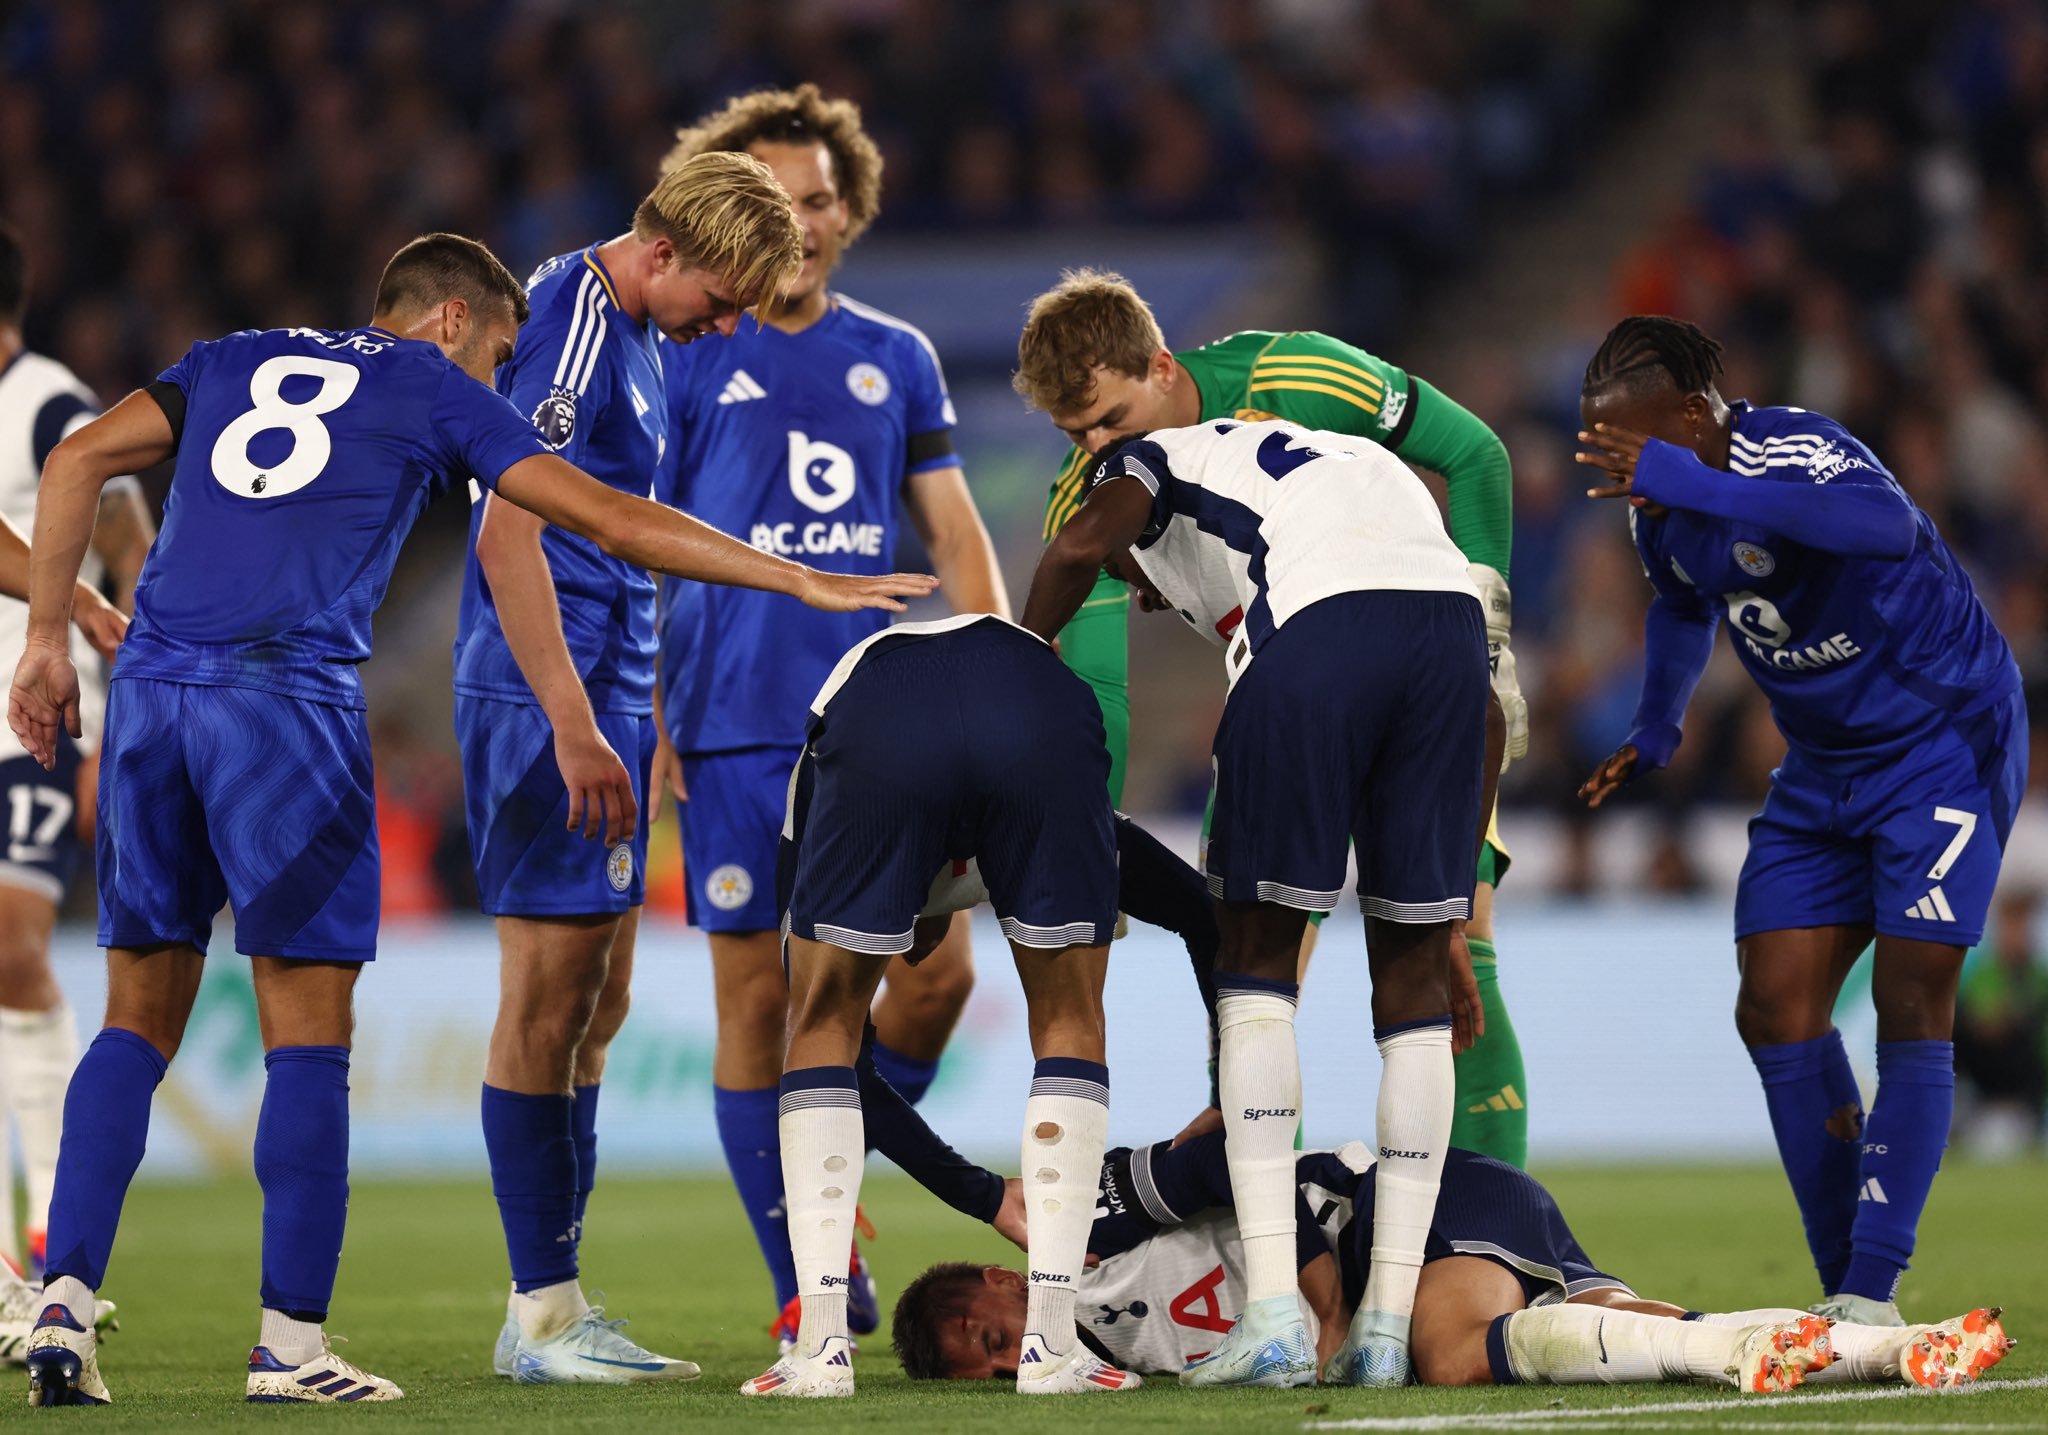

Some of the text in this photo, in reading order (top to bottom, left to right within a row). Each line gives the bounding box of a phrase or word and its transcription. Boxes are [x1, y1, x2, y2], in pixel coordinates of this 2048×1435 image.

[211, 355, 360, 499] 8
[751, 521, 884, 556] BC.GAME
[1746, 633, 1861, 670] BGAME
[8, 784, 73, 845] 17
[1927, 806, 1977, 880] 7
[1244, 1108, 1296, 1120] Spurs
[1380, 1147, 1429, 1159] Spurs
[1862, 1143, 1888, 1154] FC
[1030, 1270, 1071, 1283] Spurs
